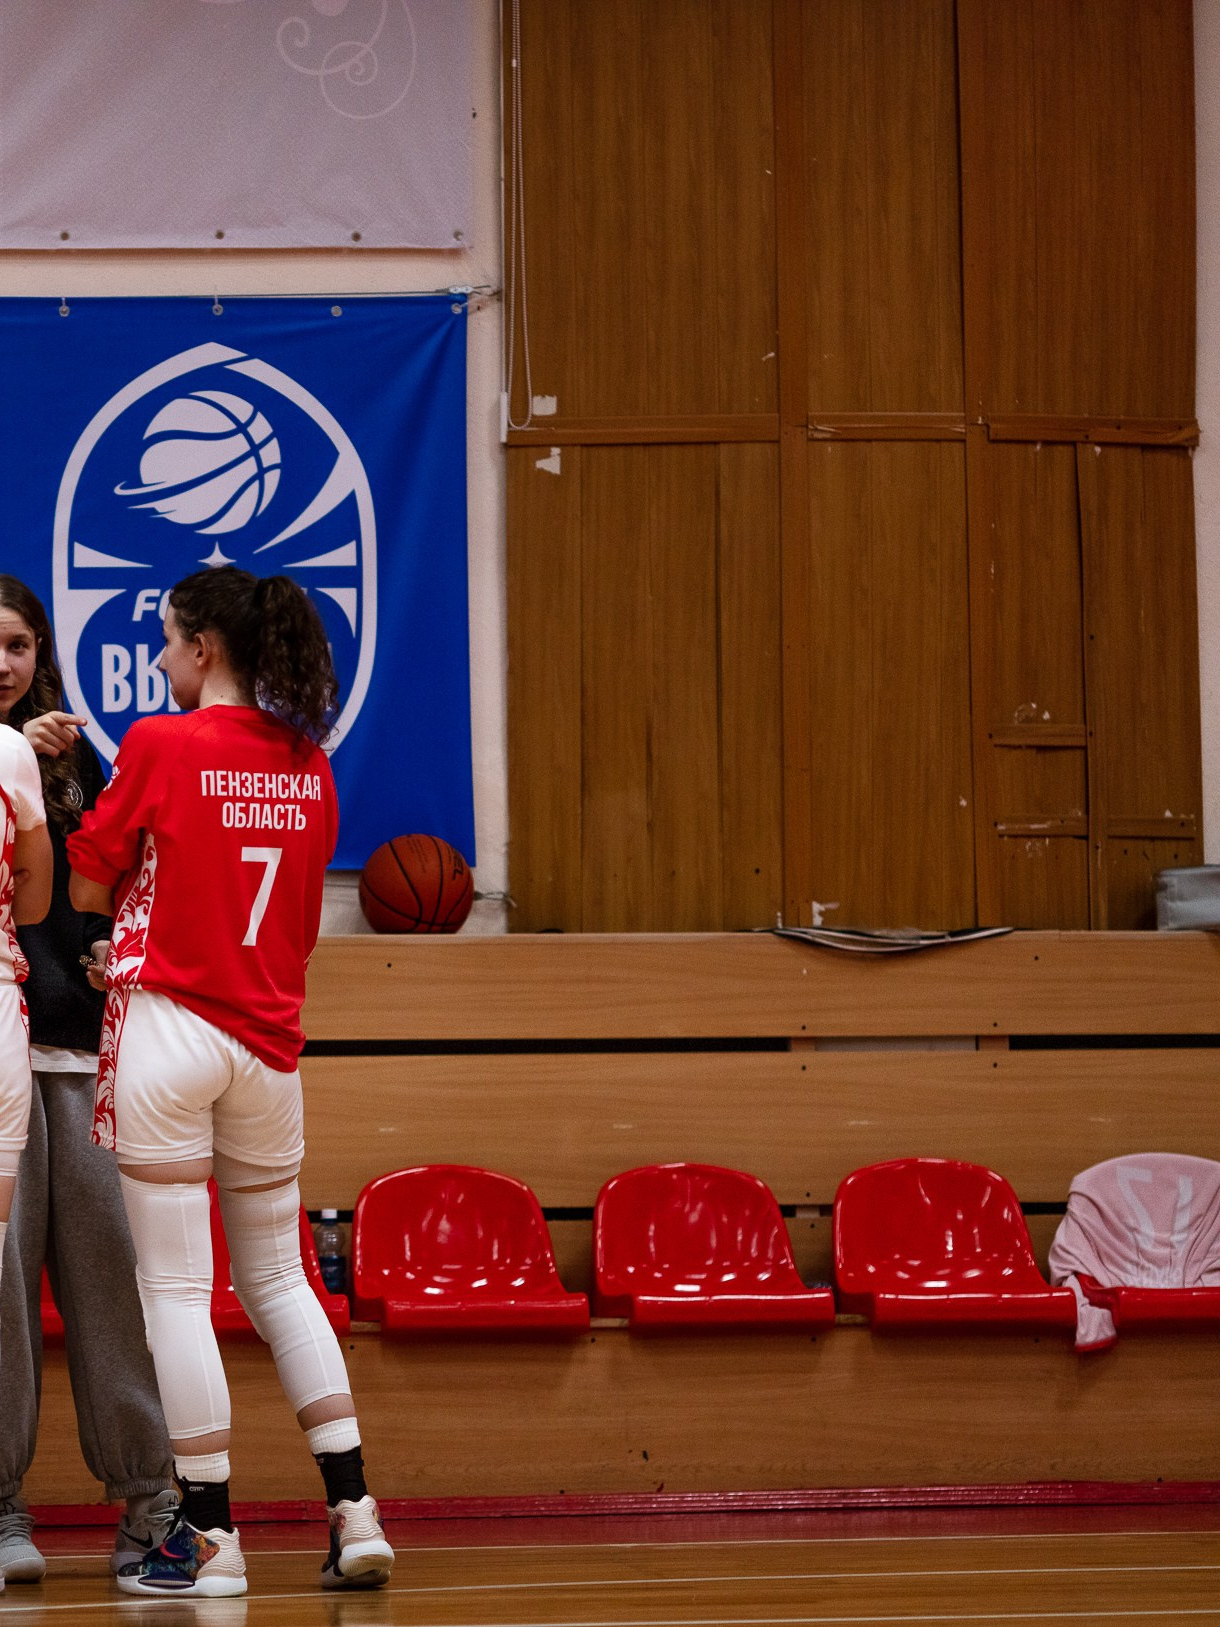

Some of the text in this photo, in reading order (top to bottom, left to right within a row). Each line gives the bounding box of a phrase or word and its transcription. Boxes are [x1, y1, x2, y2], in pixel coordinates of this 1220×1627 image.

[200, 769, 321, 801] ПЕНЗЕНСКАЯ
[221, 801, 307, 831] ОБЛАСТЬ
[240, 846, 284, 947] 7
